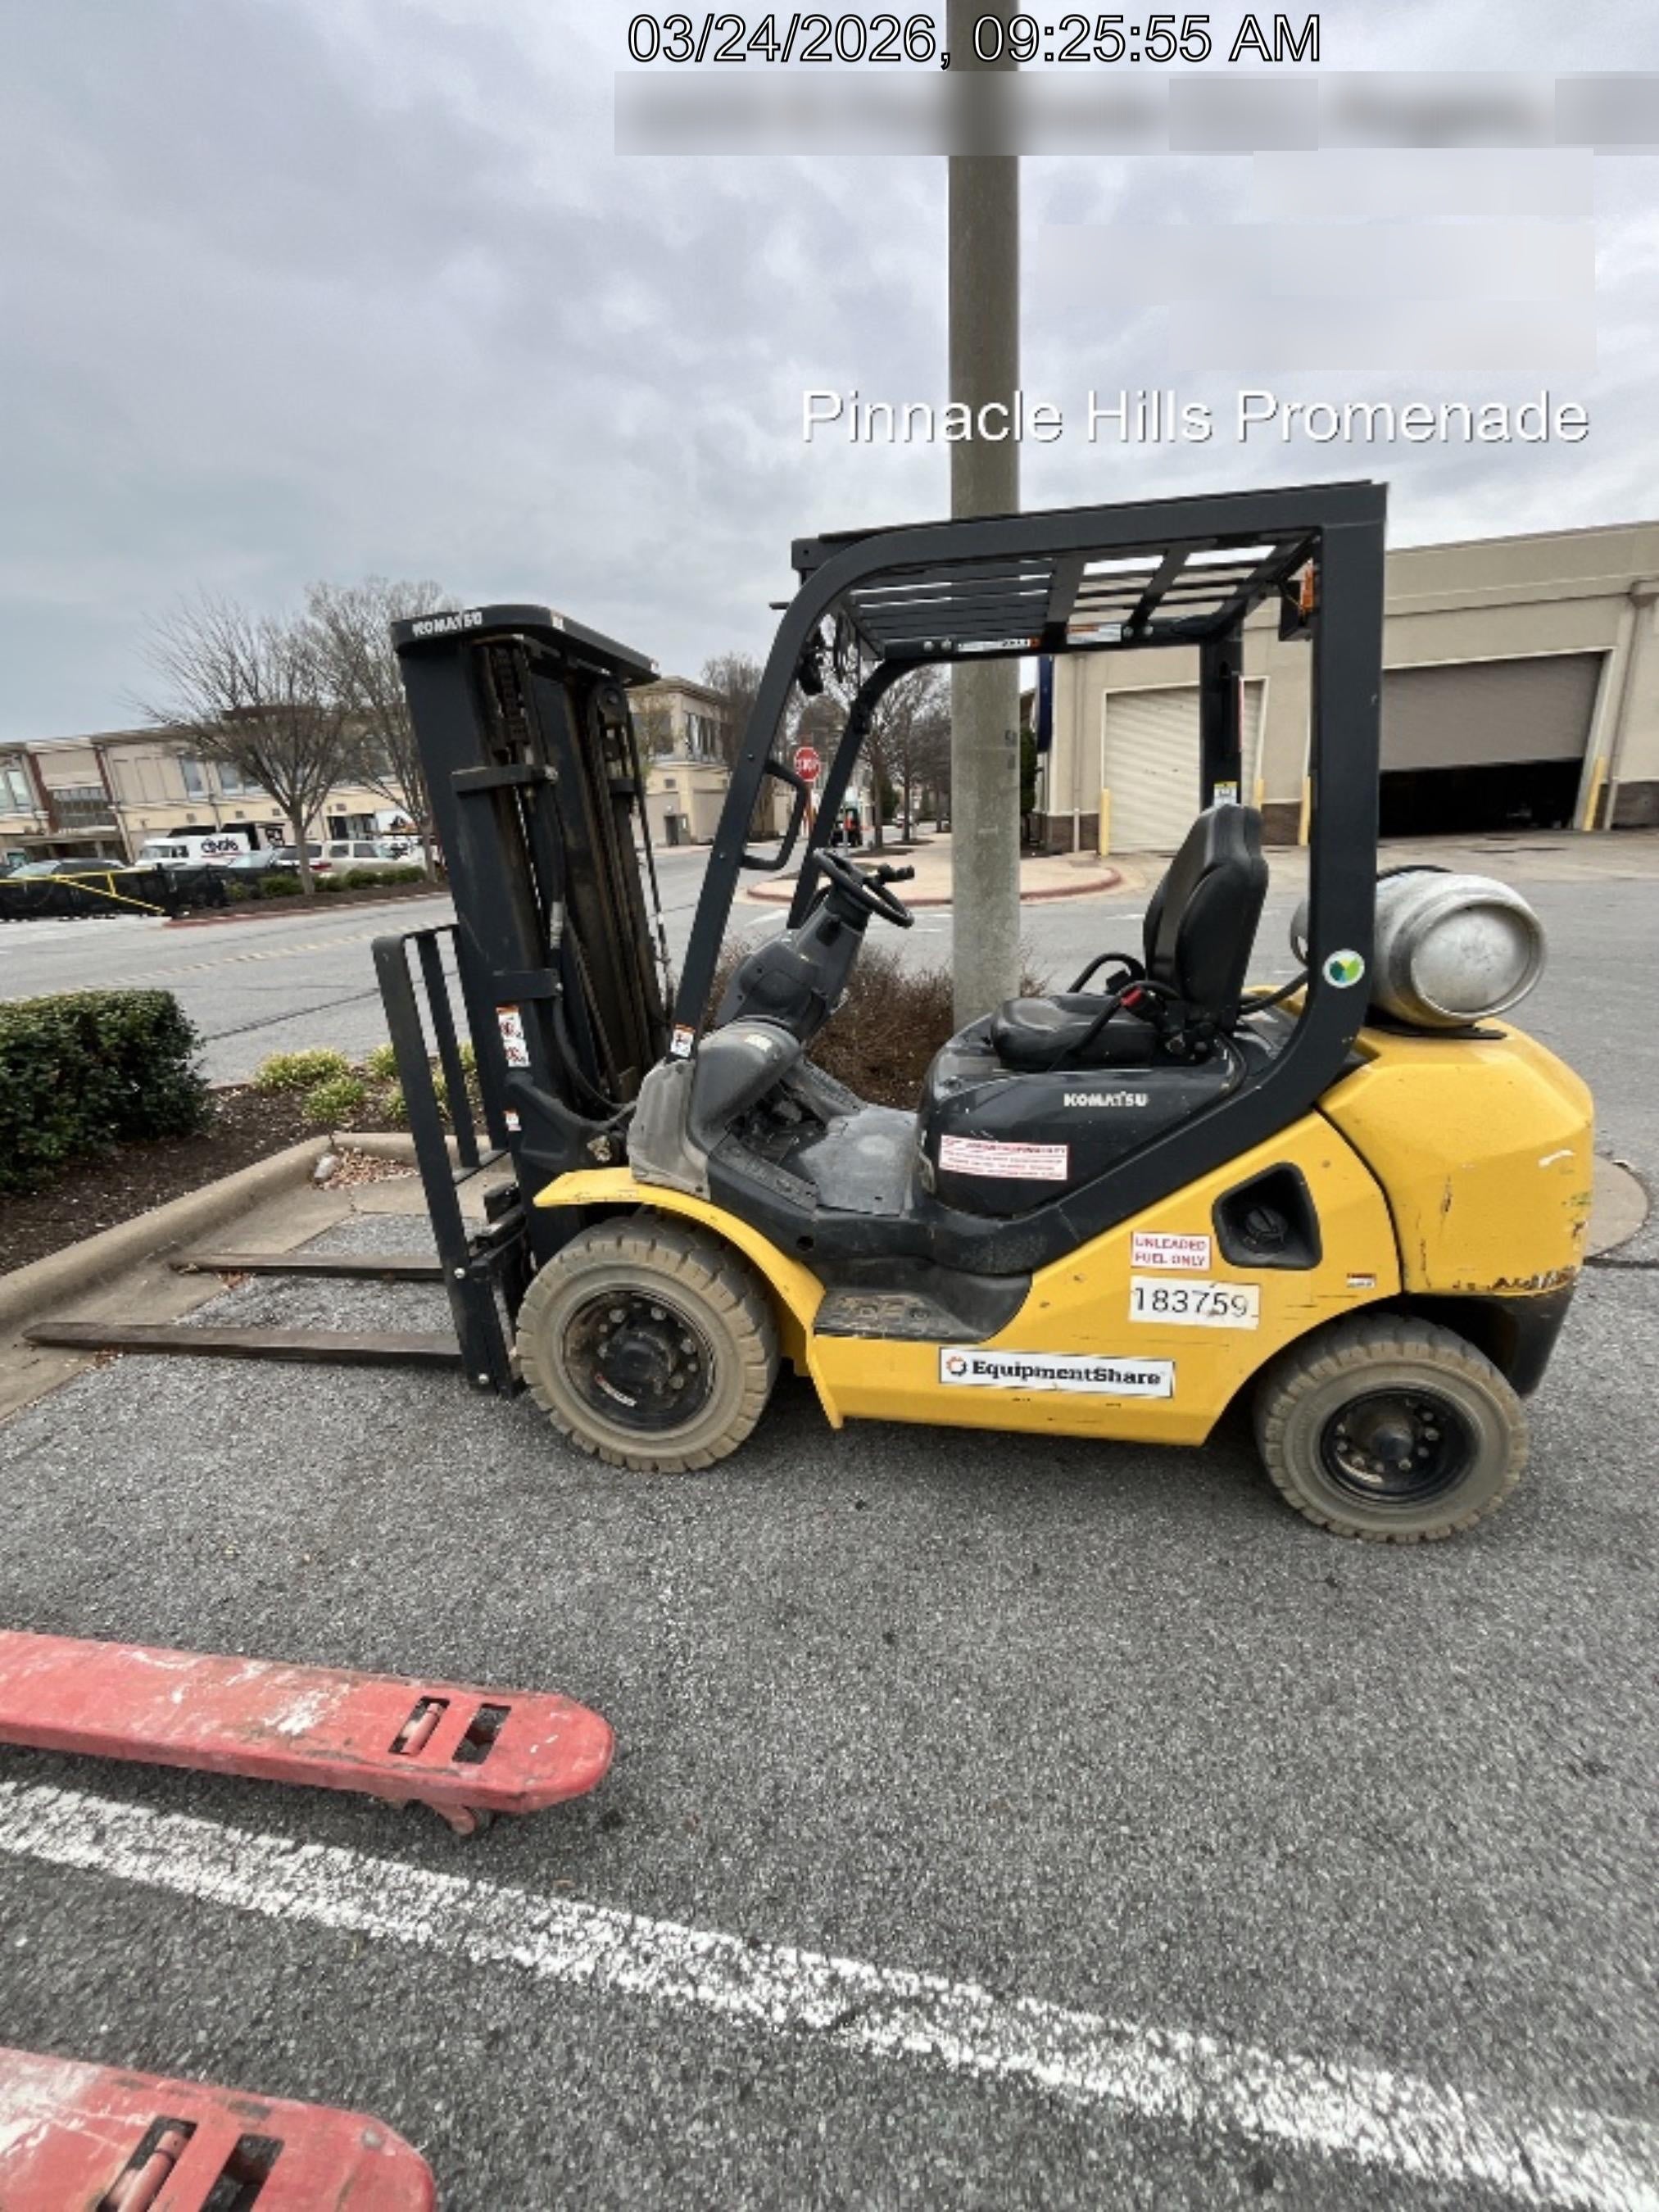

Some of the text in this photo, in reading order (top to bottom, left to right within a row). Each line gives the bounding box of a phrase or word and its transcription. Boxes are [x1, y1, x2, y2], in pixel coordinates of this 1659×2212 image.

[1063, 1090, 1149, 1107] KOMATSU
[1135, 1236, 1206, 1251] UNLEADED
[1135, 1252, 1205, 1267] FUEL ONLY
[1135, 1287, 1248, 1317] 183759
[972, 1360, 1161, 1385] EquipmentShare
